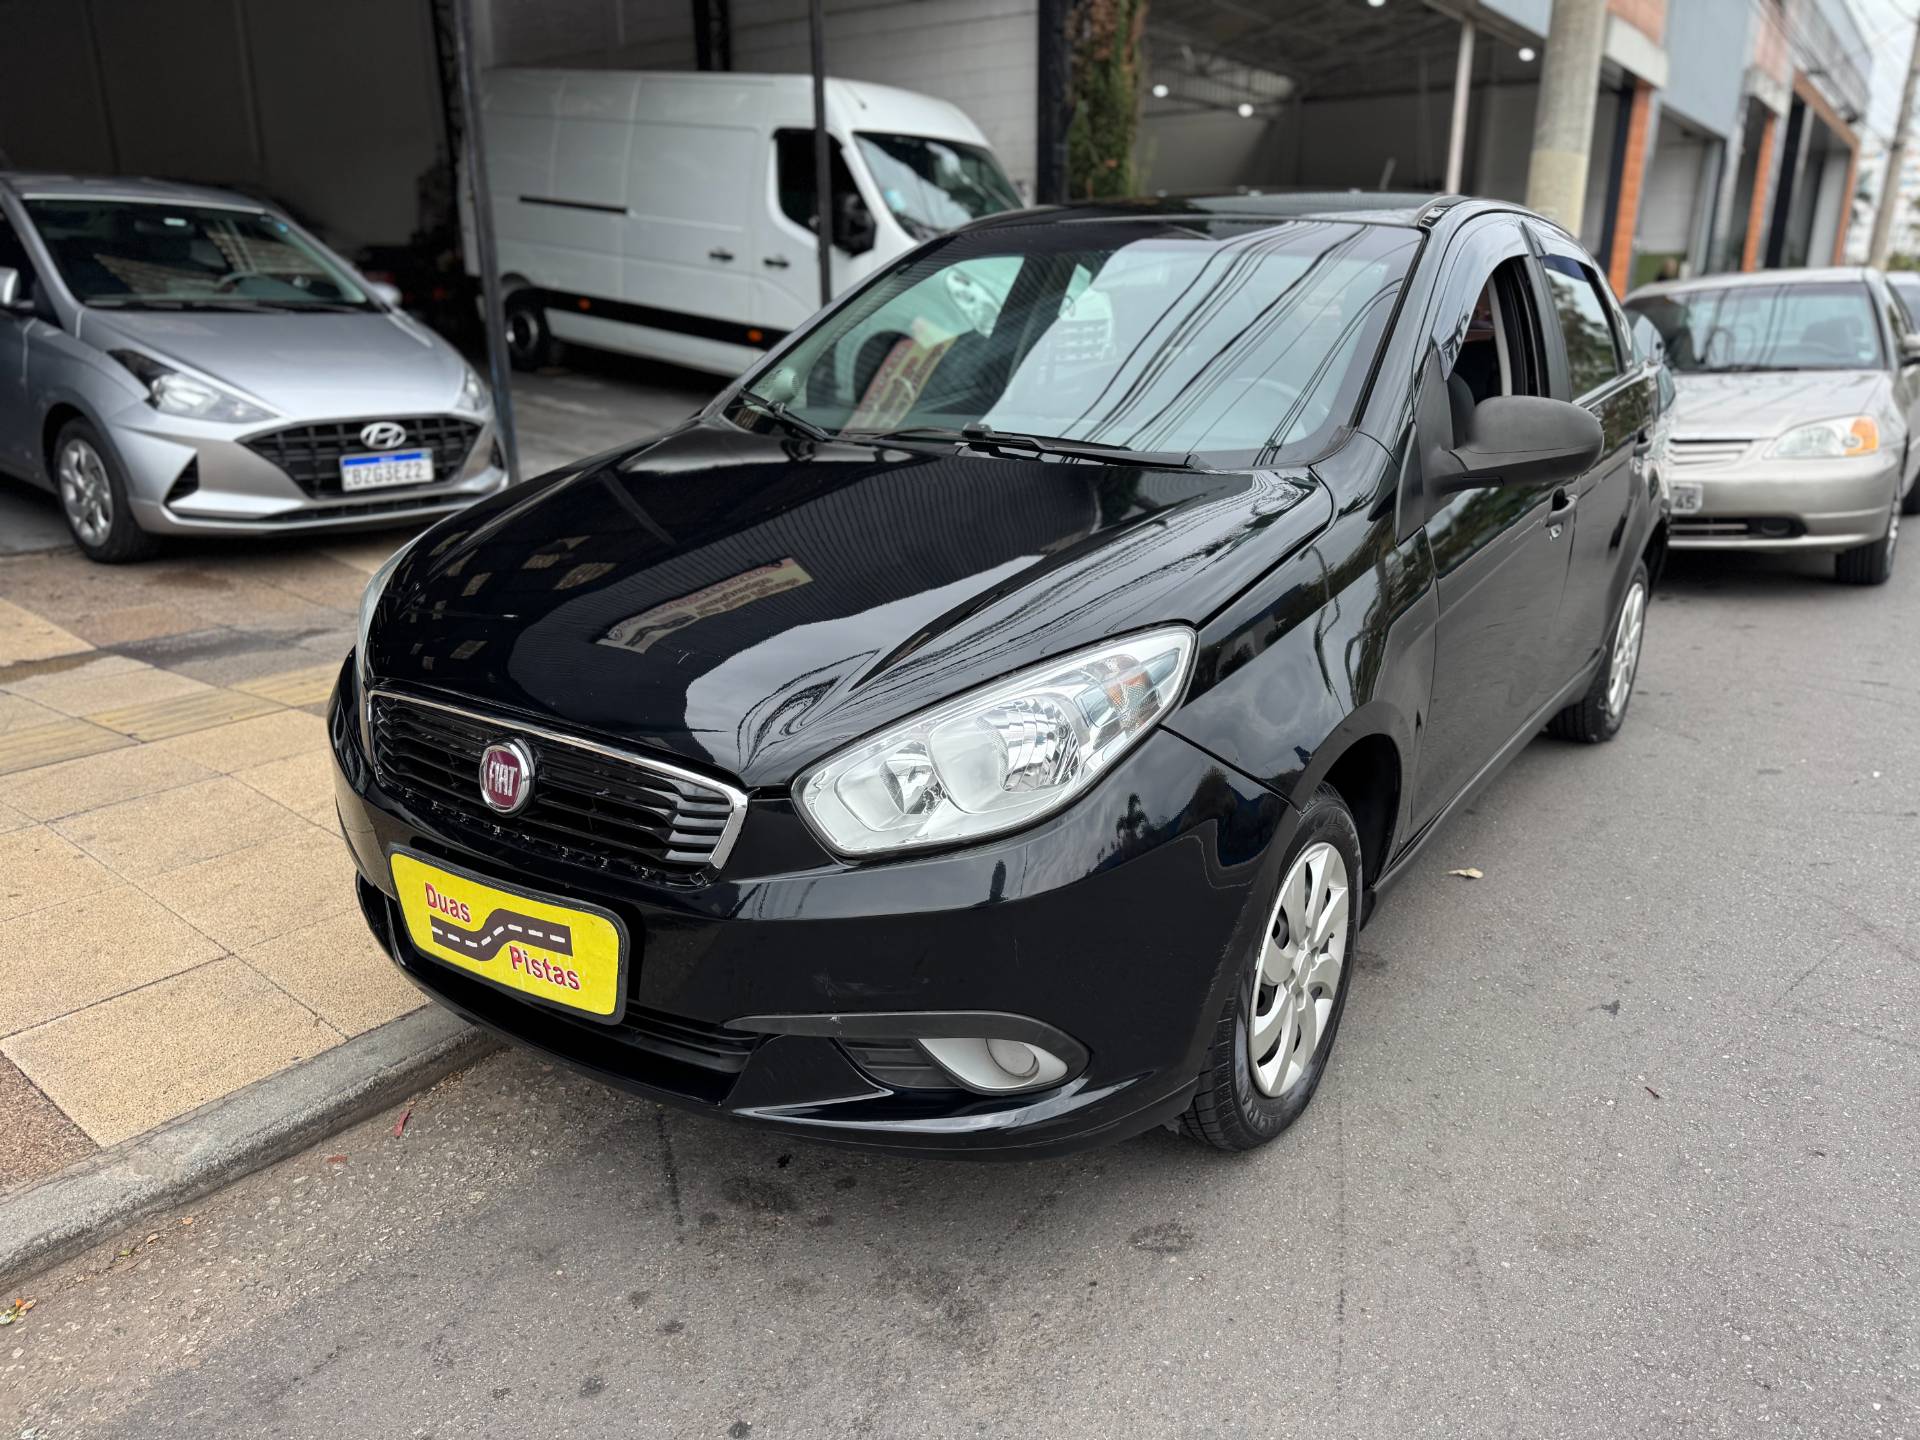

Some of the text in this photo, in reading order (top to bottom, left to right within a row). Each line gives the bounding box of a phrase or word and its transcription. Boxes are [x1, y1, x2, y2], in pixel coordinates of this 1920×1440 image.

[488, 760, 518, 797] FIAT
[424, 882, 471, 923] Duas
[509, 945, 581, 990] Pistas
